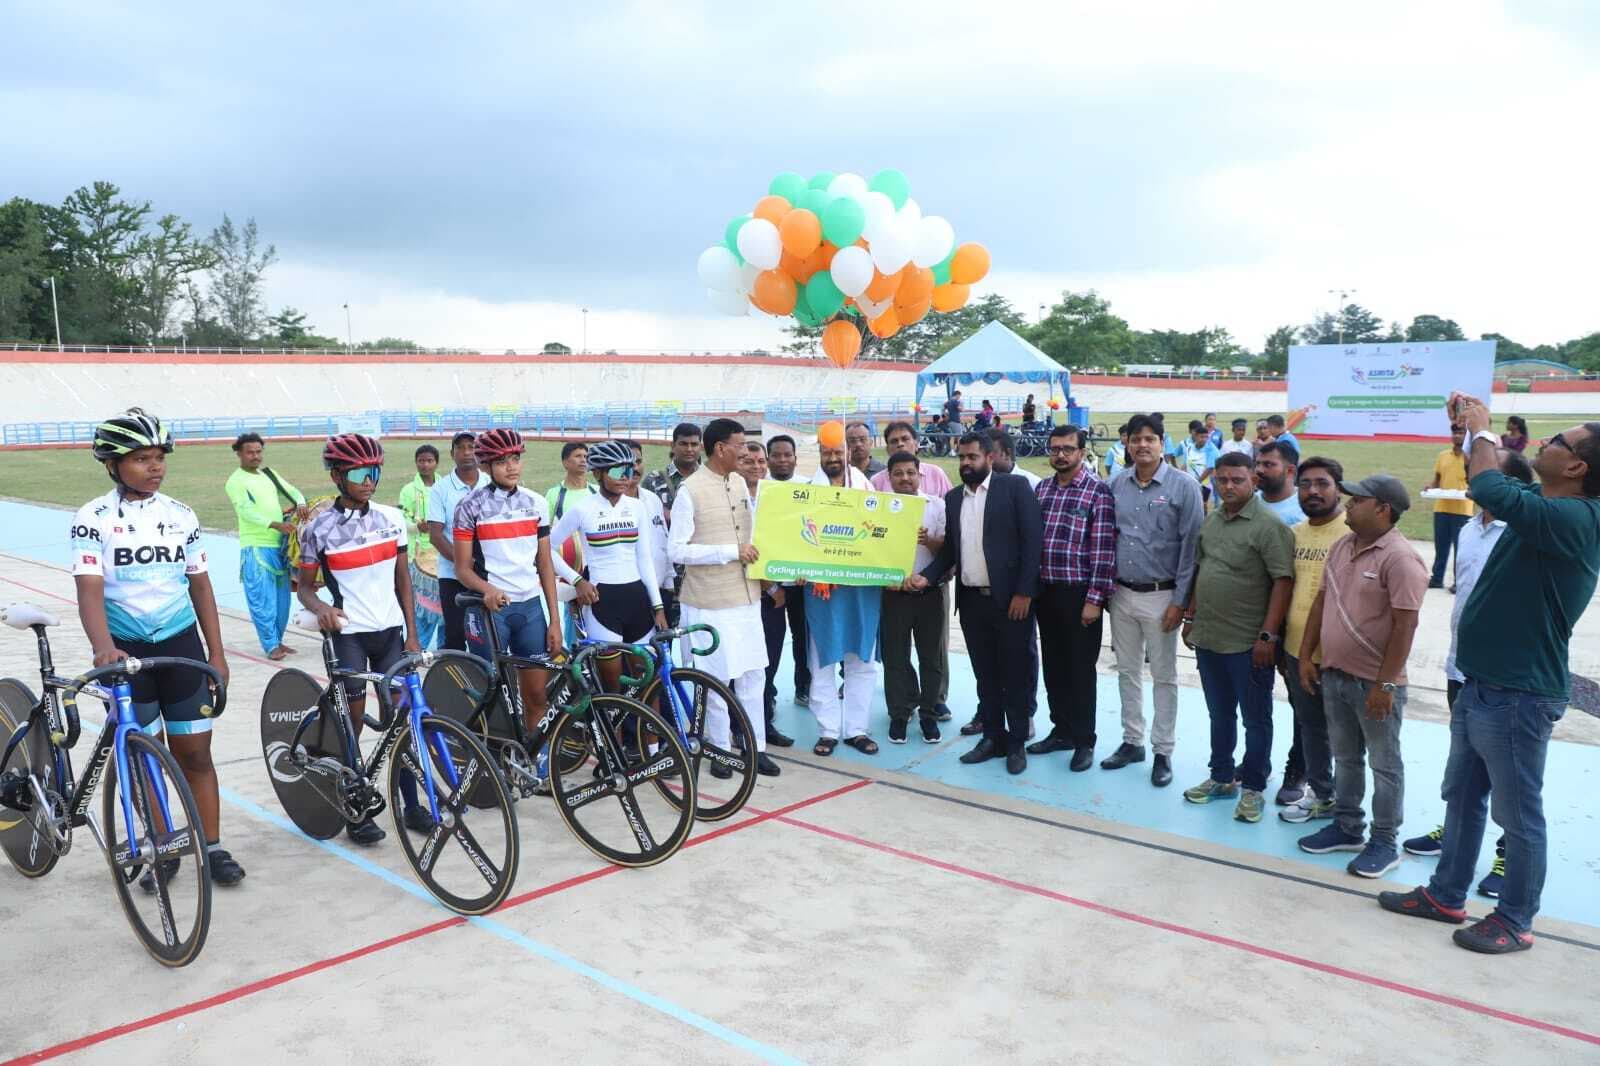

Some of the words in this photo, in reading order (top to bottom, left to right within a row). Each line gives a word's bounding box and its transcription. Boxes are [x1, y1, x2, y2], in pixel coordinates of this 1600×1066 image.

[71, 524, 104, 545] BOR
[187, 528, 200, 545] BO
[822, 524, 855, 537] ASMITA
[113, 545, 186, 567] BORA
[1295, 547, 1328, 561] ARADIS
[767, 565, 796, 576] Cycling
[797, 567, 823, 576] League
[628, 756, 675, 782] CORIMA
[703, 748, 745, 771] CORIMA
[75, 746, 113, 816] PINARELLO
[452, 757, 479, 807] CORIMA
[566, 783, 608, 807] CORIMA
[621, 795, 652, 852] CORIMA
[419, 825, 443, 872] CORIMA
[456, 828, 499, 885] CORIMA
